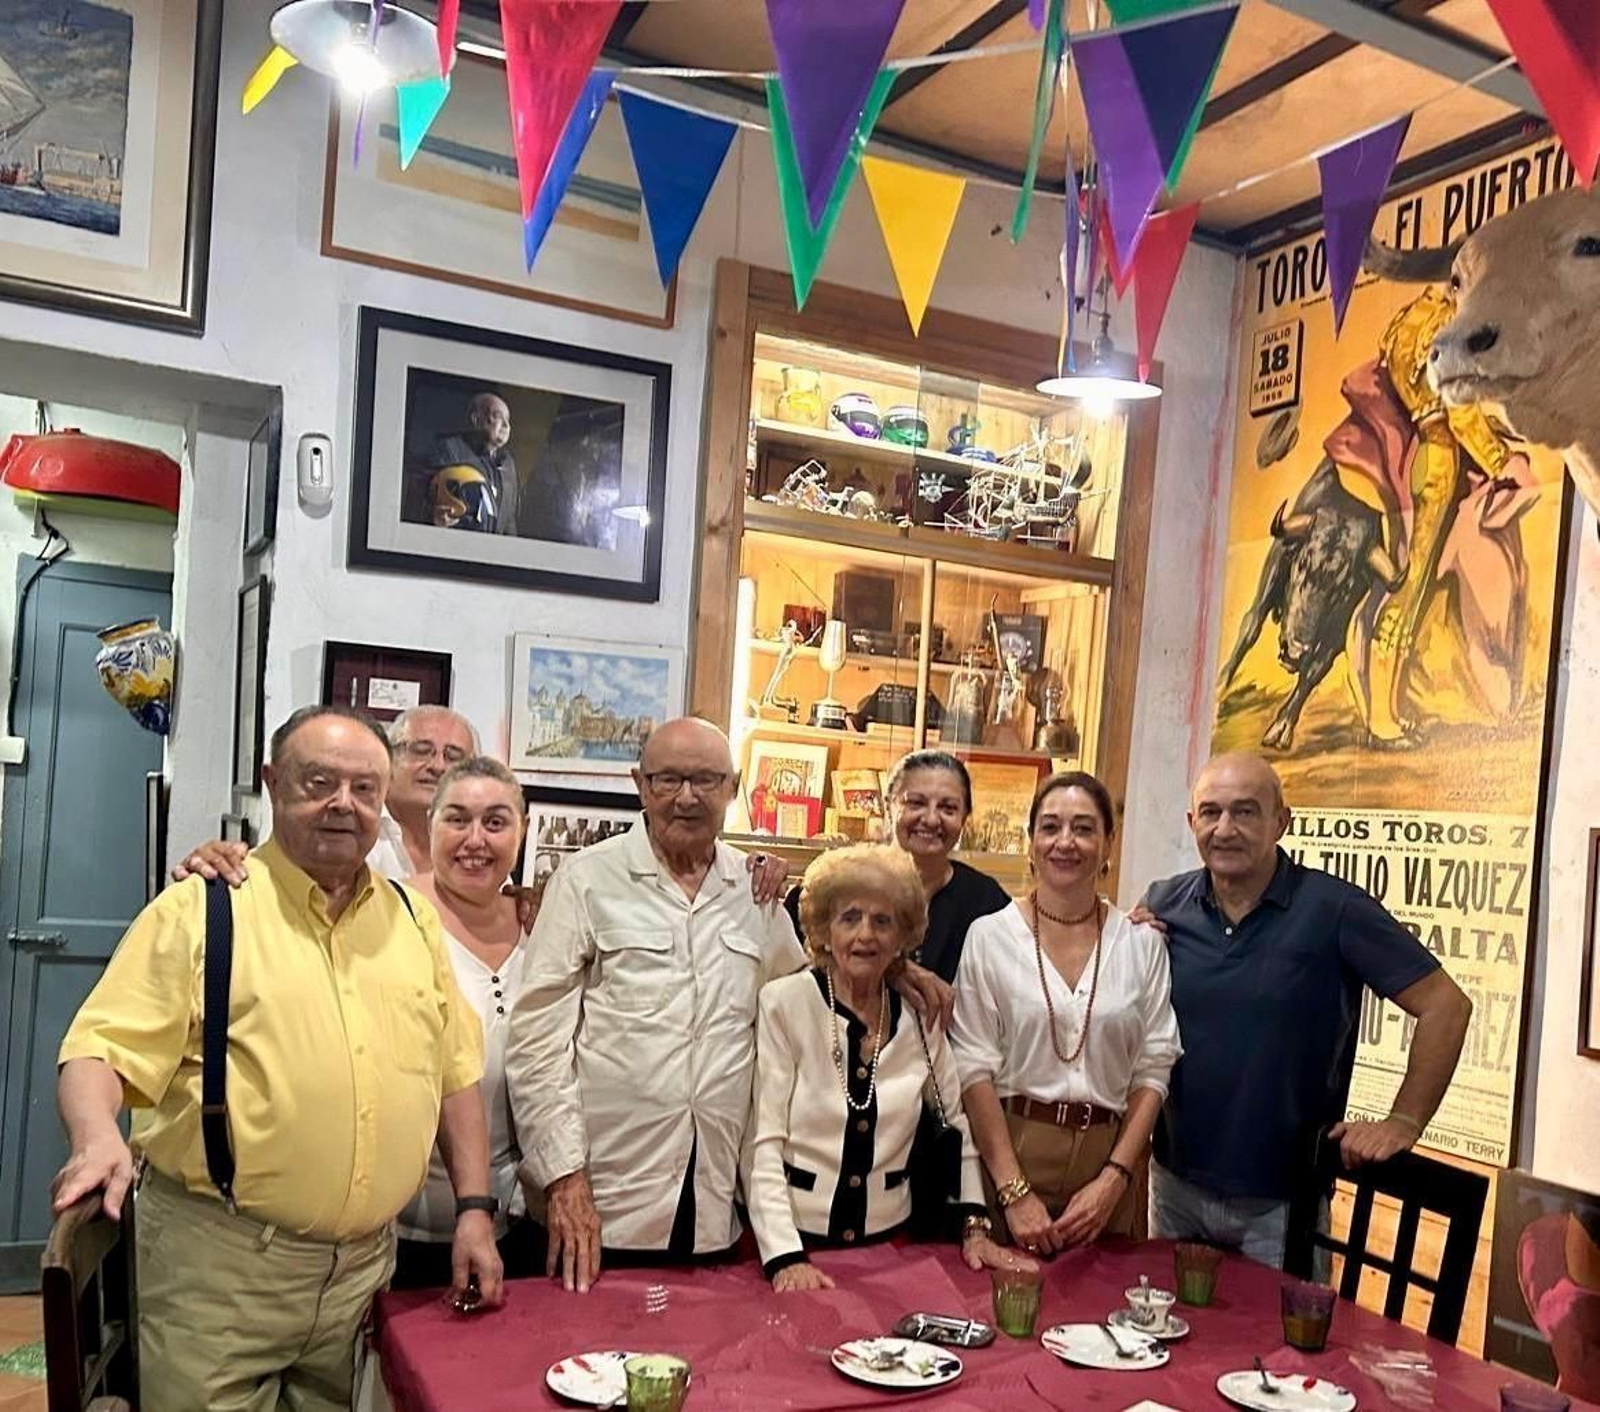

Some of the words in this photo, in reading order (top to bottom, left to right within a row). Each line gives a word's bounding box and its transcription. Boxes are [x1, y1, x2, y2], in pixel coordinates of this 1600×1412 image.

[1257, 237, 1328, 313] TORO
[1262, 327, 1291, 346] JULIO
[1259, 344, 1289, 379] 18
[1286, 816, 1370, 840] ILLOS
[1510, 825, 1530, 849] 7
[1404, 857, 1528, 916] VAZQUEZ
[1422, 1131, 1458, 1148] NARIO
[1465, 1140, 1504, 1160] TERRY
